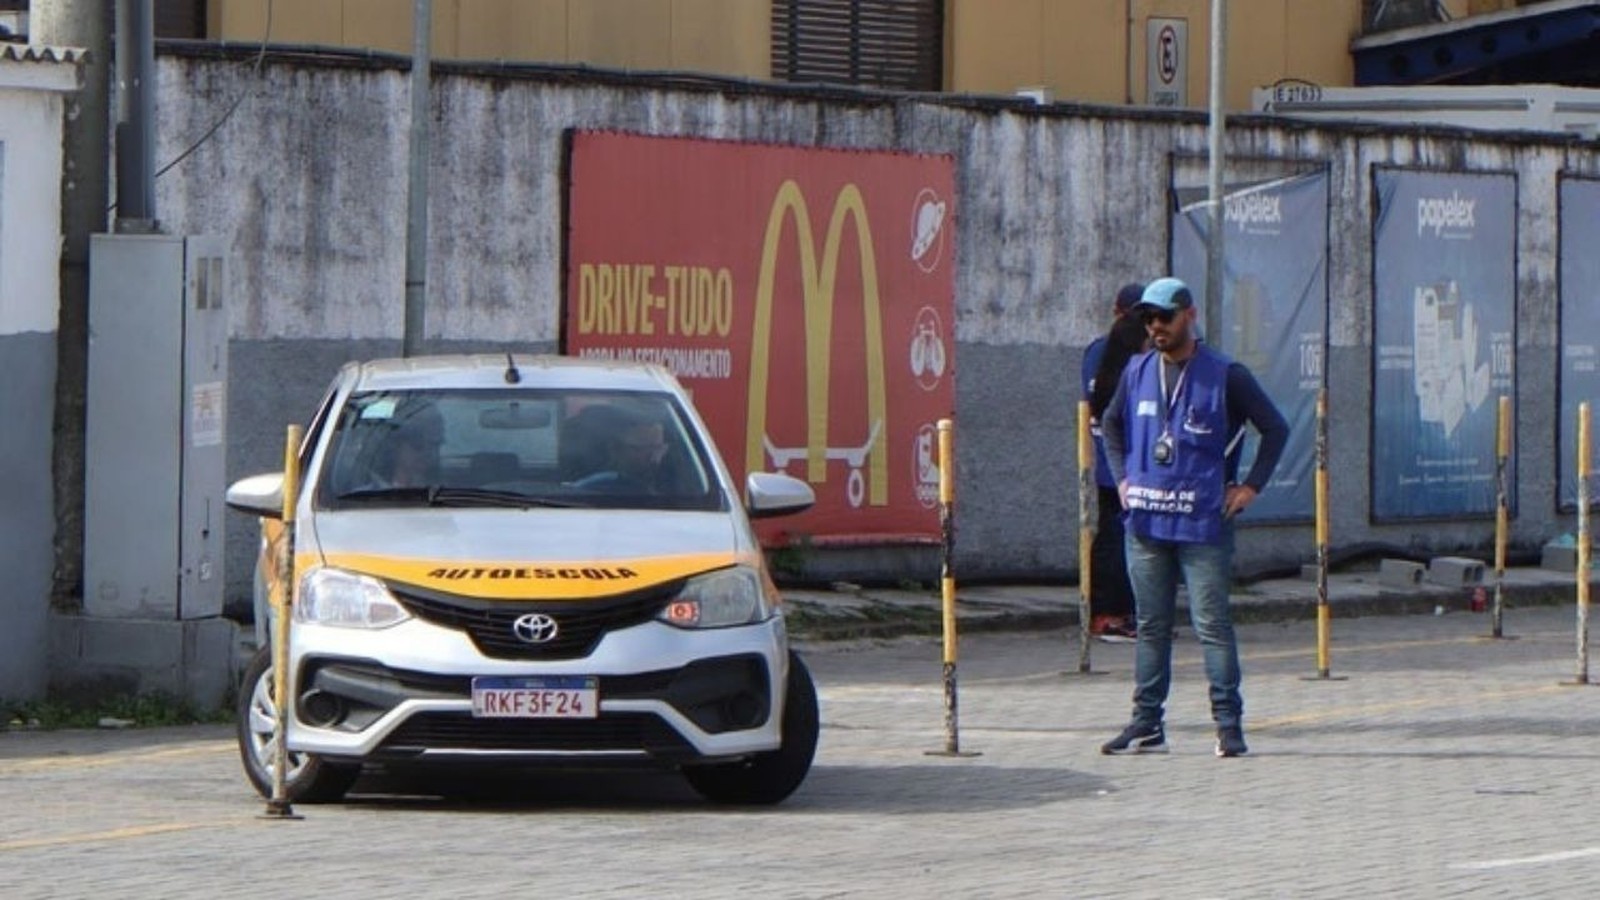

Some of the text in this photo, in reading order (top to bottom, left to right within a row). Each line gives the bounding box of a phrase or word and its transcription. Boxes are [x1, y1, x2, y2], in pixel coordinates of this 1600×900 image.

[1418, 189, 1476, 237] papelex
[578, 263, 734, 337] DRIVE-TUDO
[1179, 491, 1196, 502] DE
[427, 567, 639, 581] AUTOESCOLA
[485, 691, 583, 714] RKF3F24
